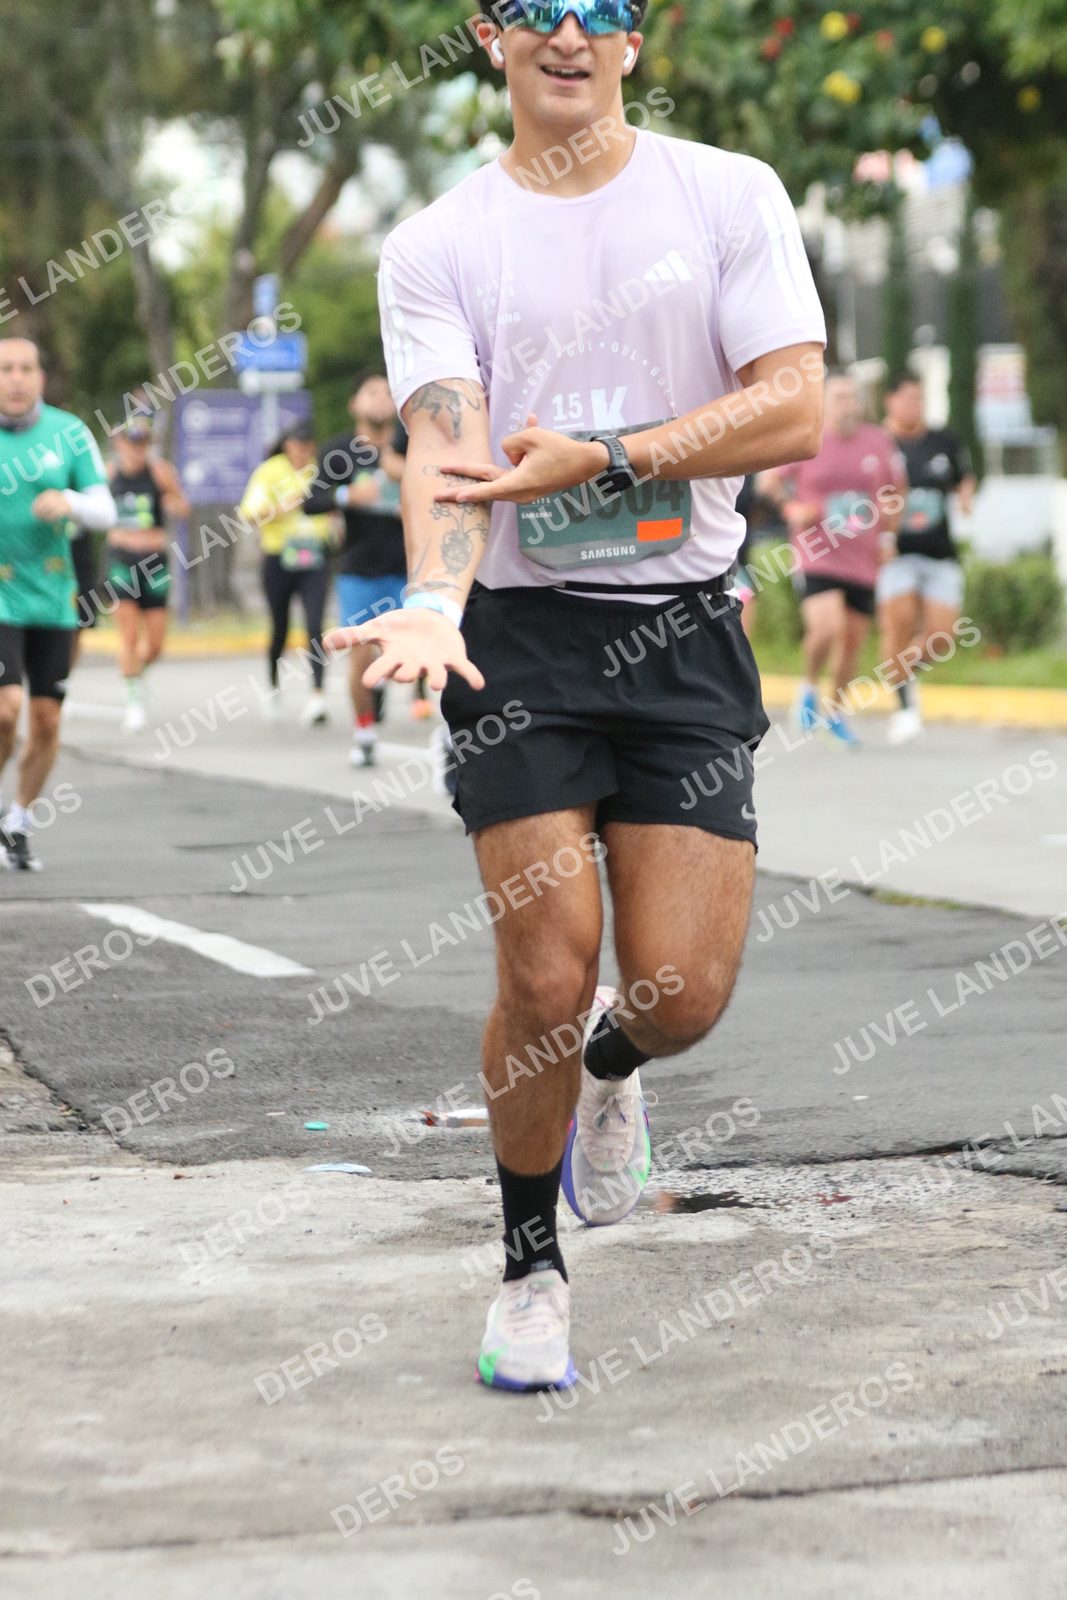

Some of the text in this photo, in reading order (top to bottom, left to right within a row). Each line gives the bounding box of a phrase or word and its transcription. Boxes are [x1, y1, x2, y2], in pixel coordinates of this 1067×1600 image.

[566, 341, 594, 357] GDL
[611, 342, 637, 361] GDL
[551, 385, 628, 430] 15 K
[580, 545, 637, 561] SAMSUNG
